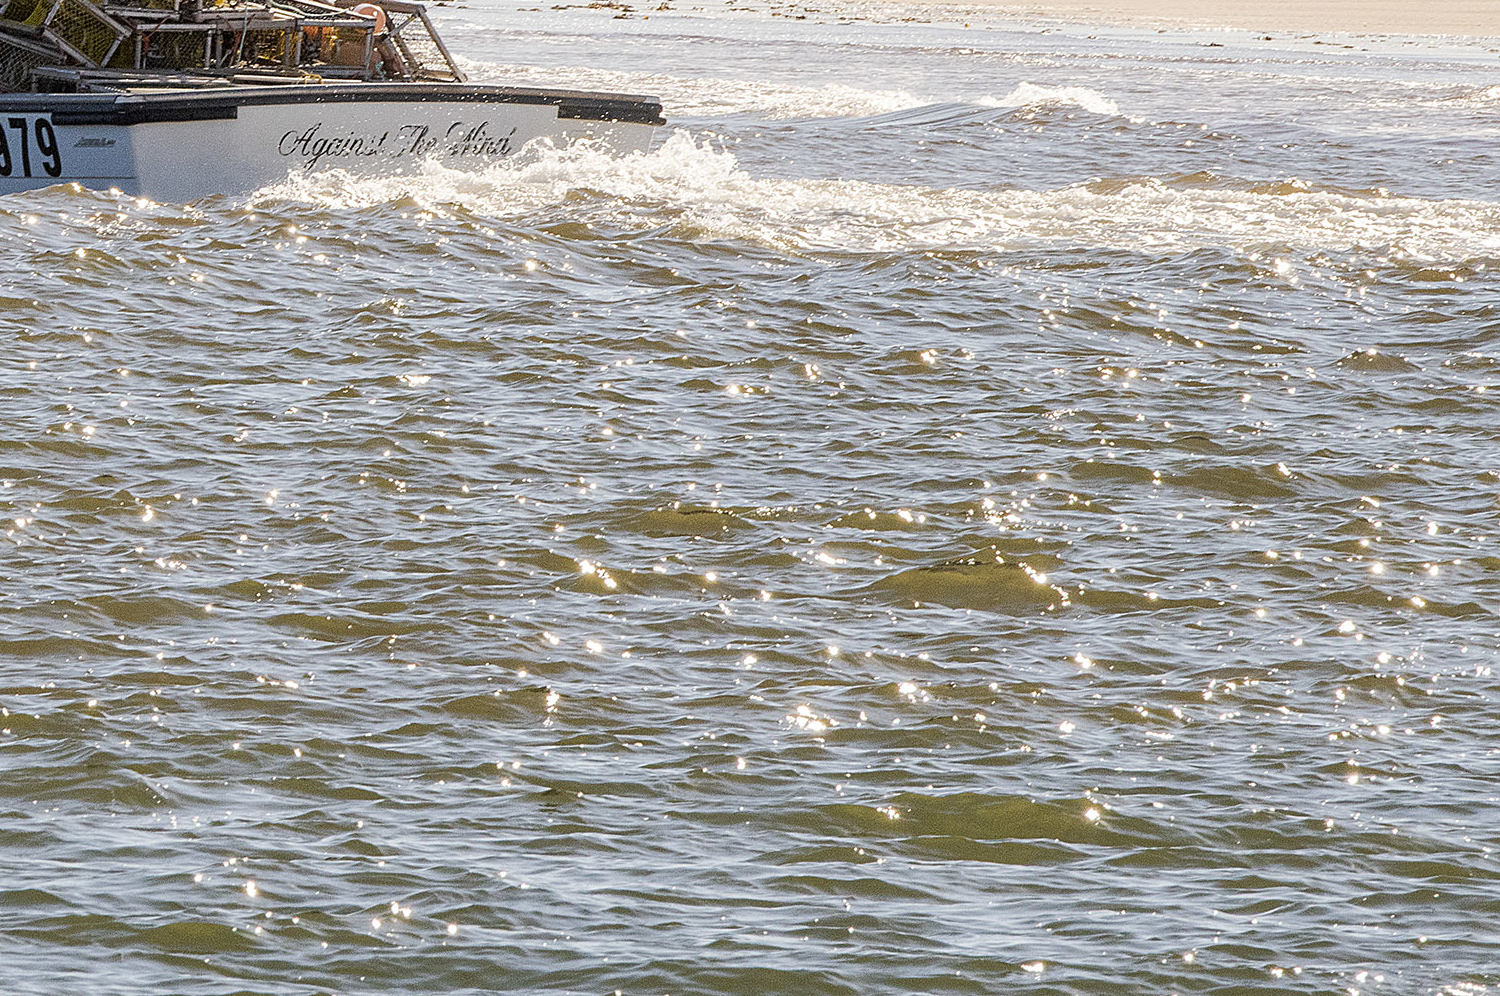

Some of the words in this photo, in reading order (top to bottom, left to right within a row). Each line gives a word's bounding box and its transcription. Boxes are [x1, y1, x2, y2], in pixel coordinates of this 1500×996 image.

[278, 122, 389, 170] Against
[395, 124, 437, 157] The
[445, 120, 518, 156] Wind
